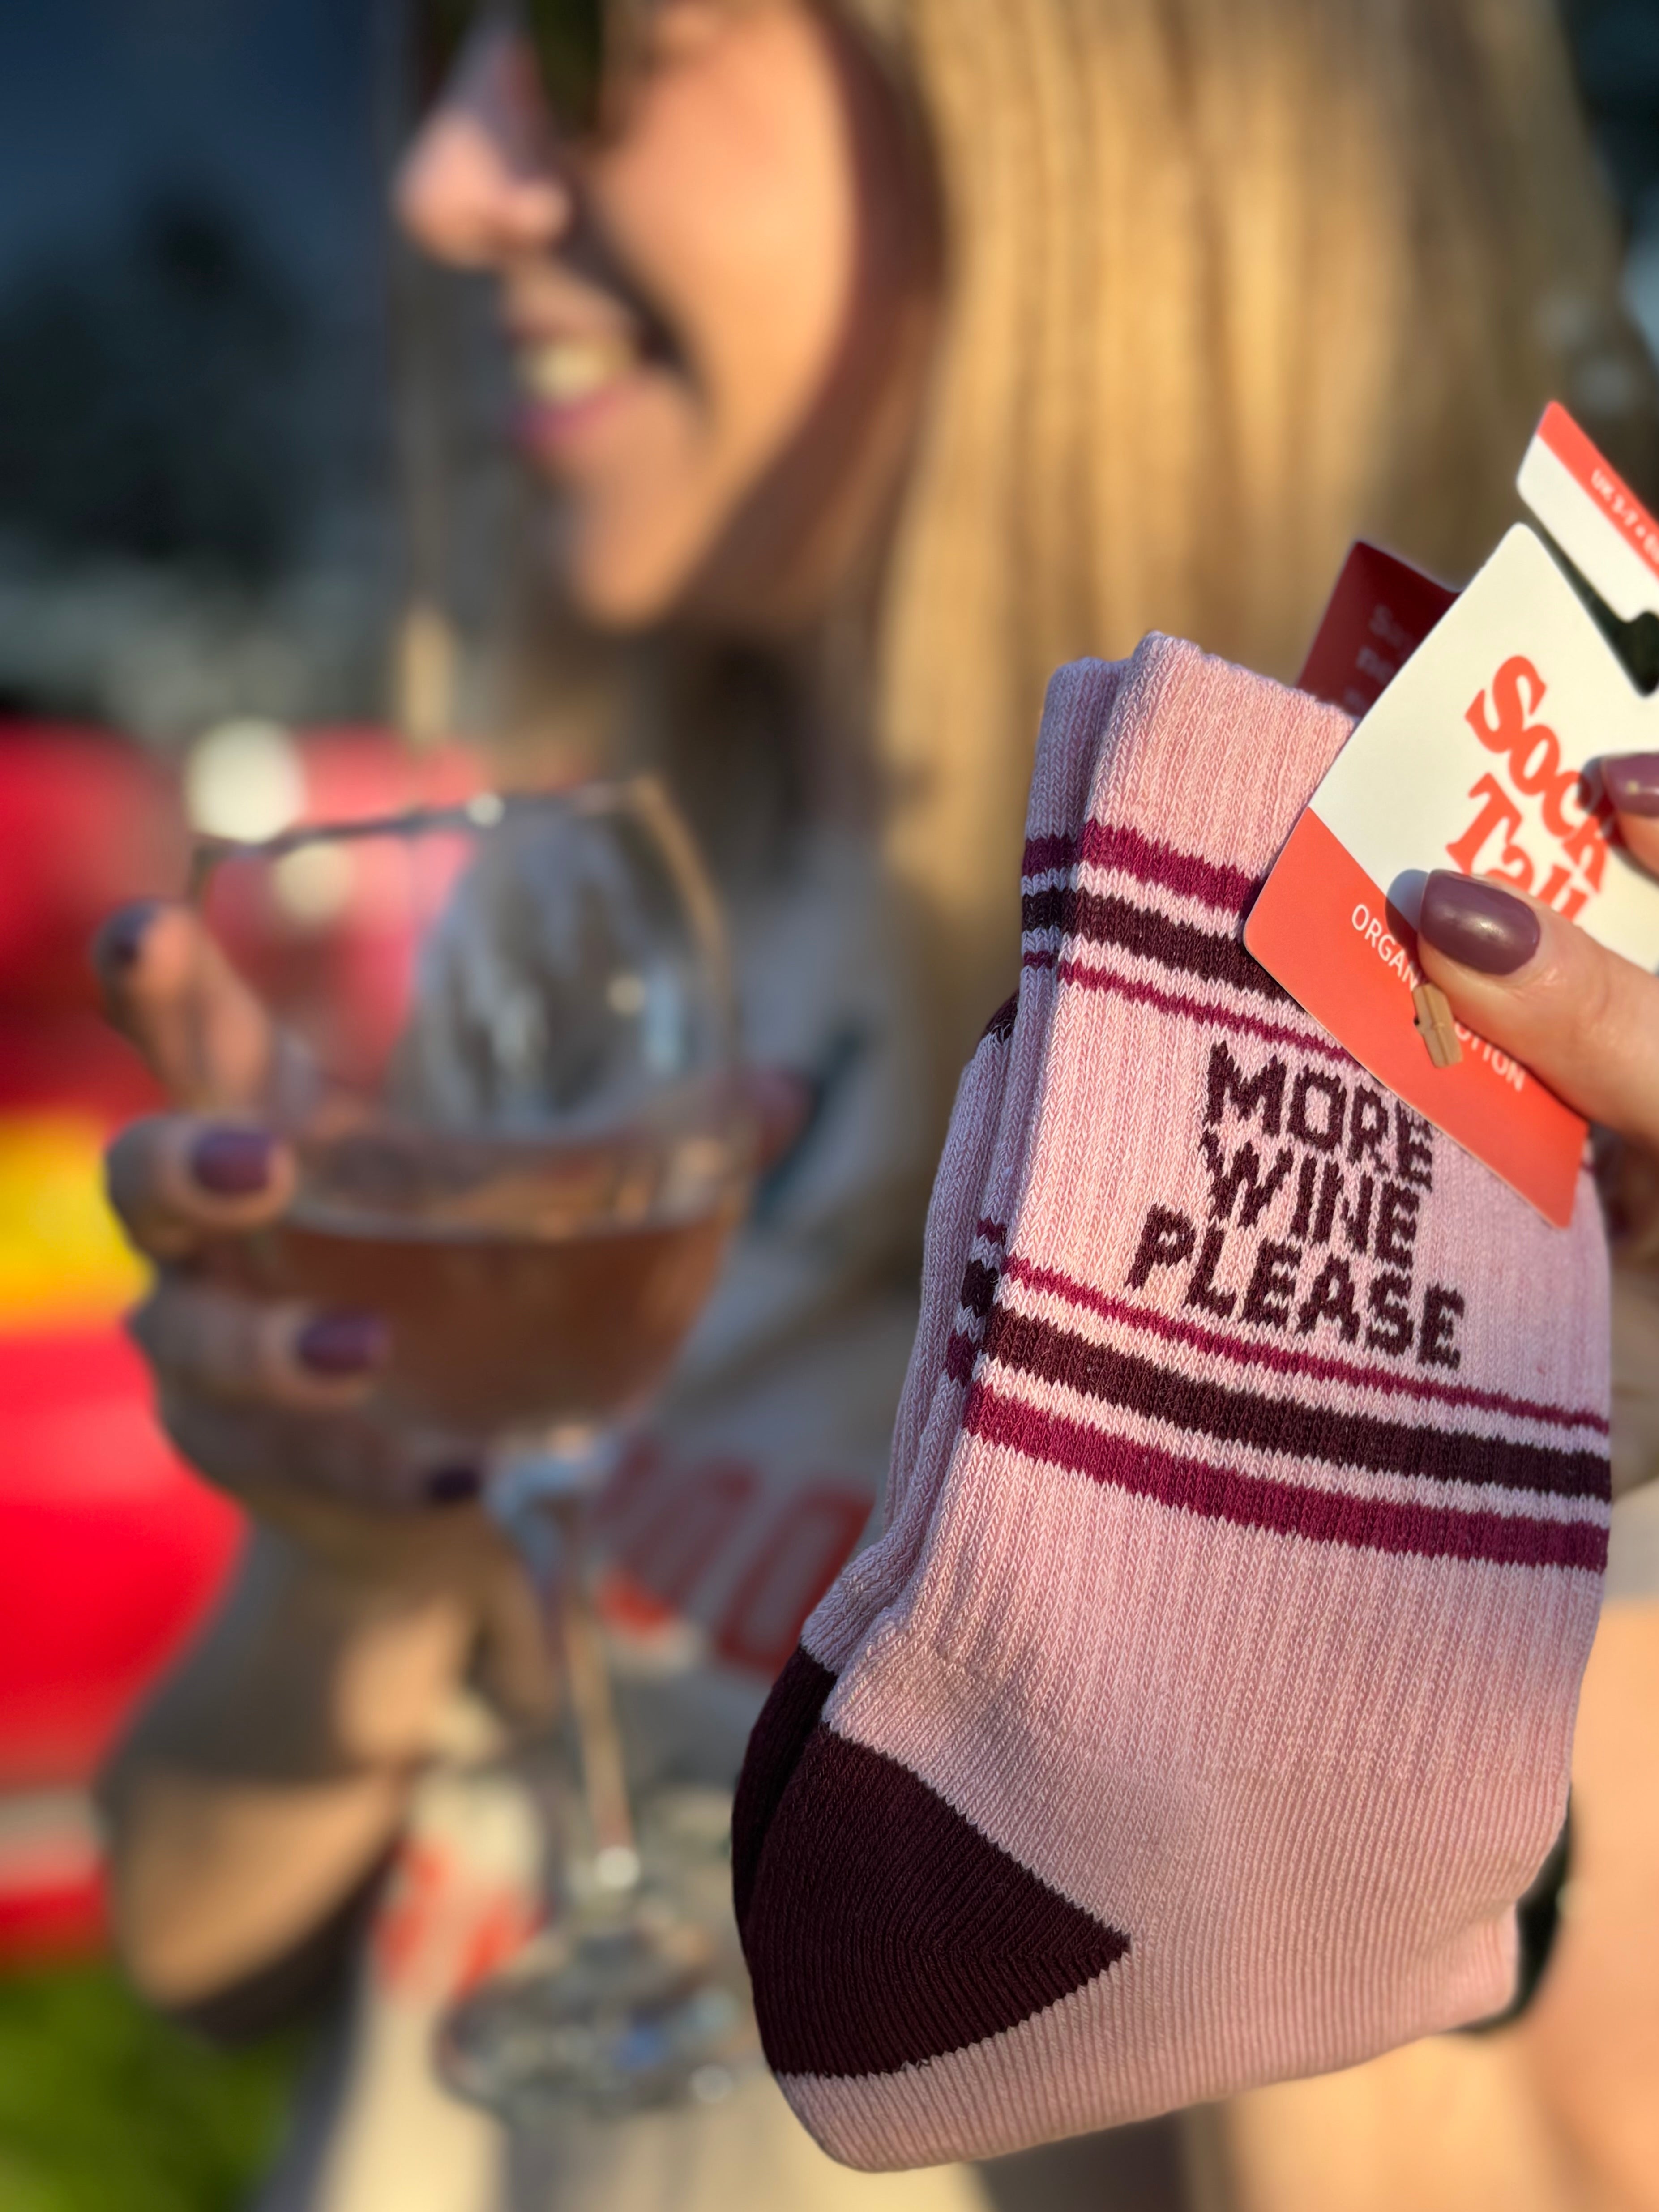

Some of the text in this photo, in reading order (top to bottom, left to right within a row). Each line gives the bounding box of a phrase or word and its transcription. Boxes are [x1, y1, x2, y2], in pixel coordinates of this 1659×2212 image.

[1352, 903, 1420, 991] ORGAN
[1201, 1039, 1433, 1193] MORE
[1197, 1129, 1420, 1272] WINE
[1124, 1203, 1465, 1370] PLEASE
